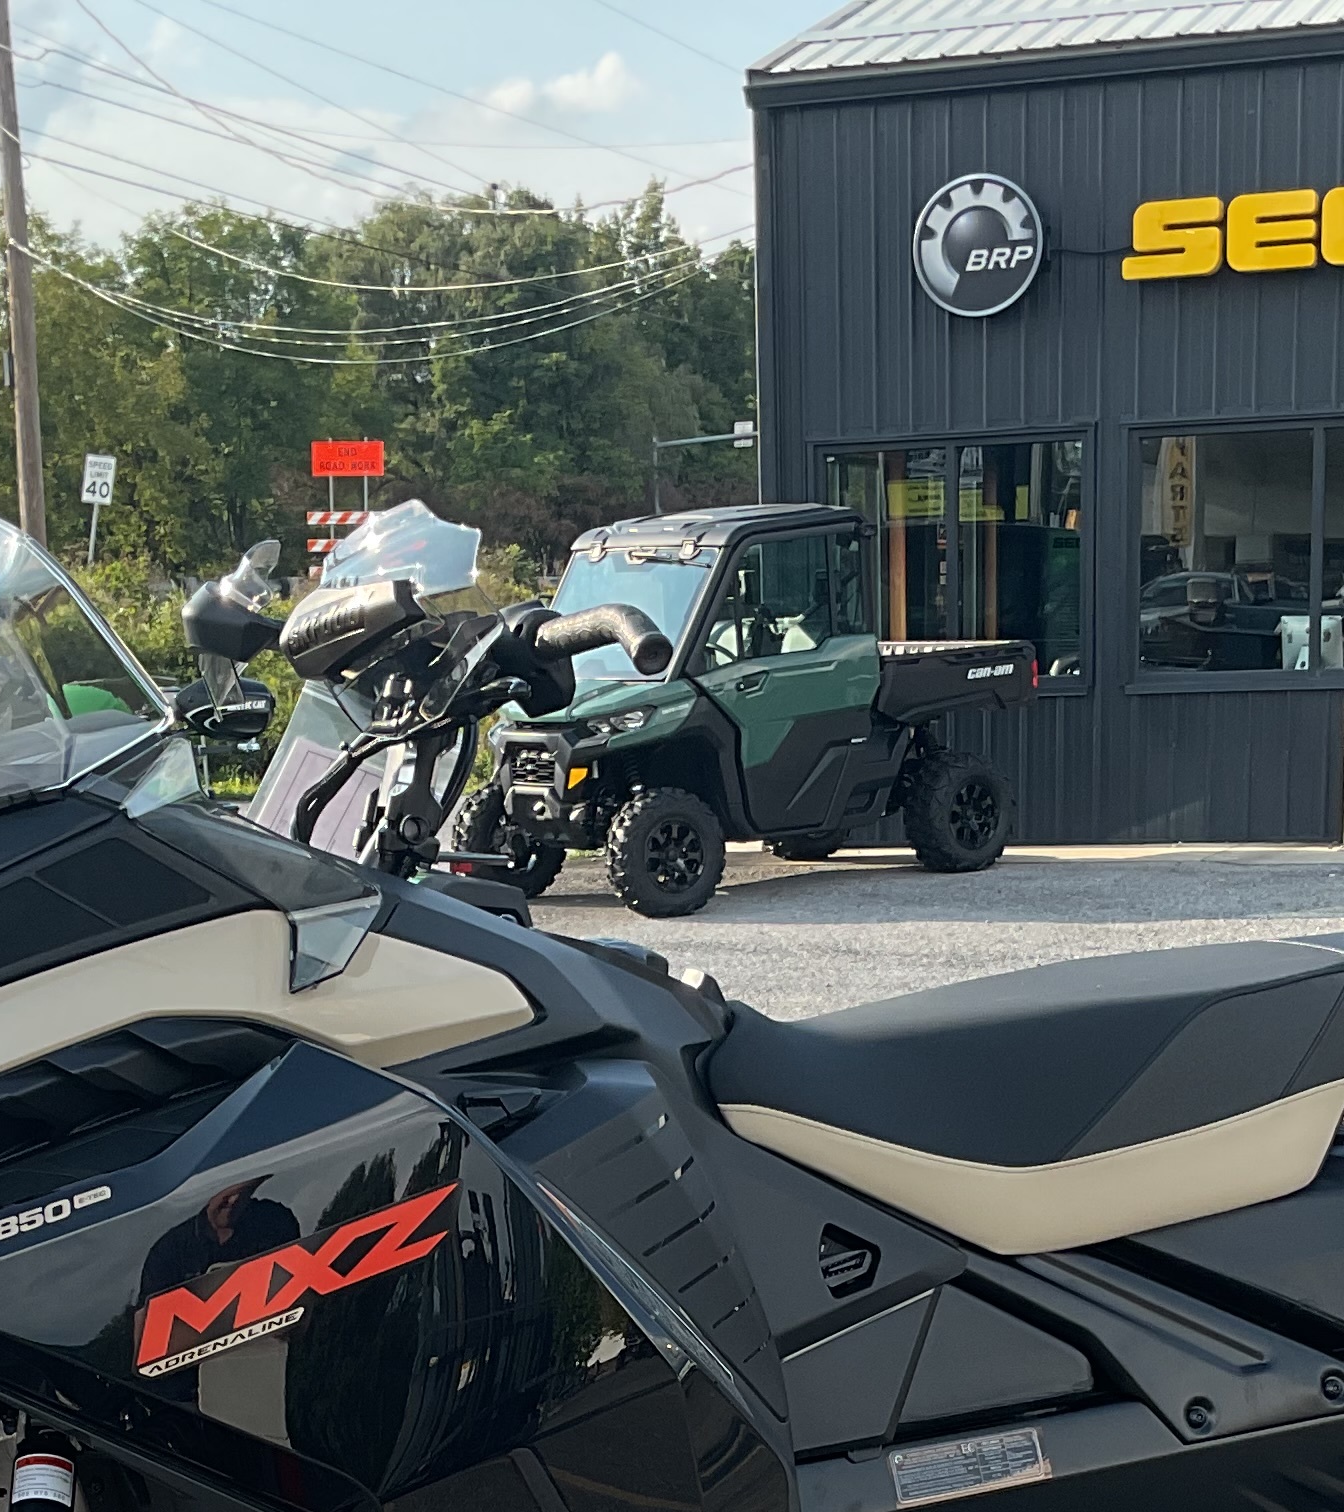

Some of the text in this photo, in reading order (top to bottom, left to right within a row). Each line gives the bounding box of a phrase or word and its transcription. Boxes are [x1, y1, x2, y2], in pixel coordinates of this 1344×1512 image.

[965, 245, 1034, 272] BRP
[338, 447, 358, 457] END
[88, 460, 113, 471] SPEED
[319, 461, 376, 471] ROAD WORK
[89, 471, 109, 479] LIMIT
[85, 480, 110, 498] 40
[967, 663, 1014, 680] can-am
[136, 1182, 459, 1367] MXZ
[147, 1310, 301, 1375] ADRENALINE
